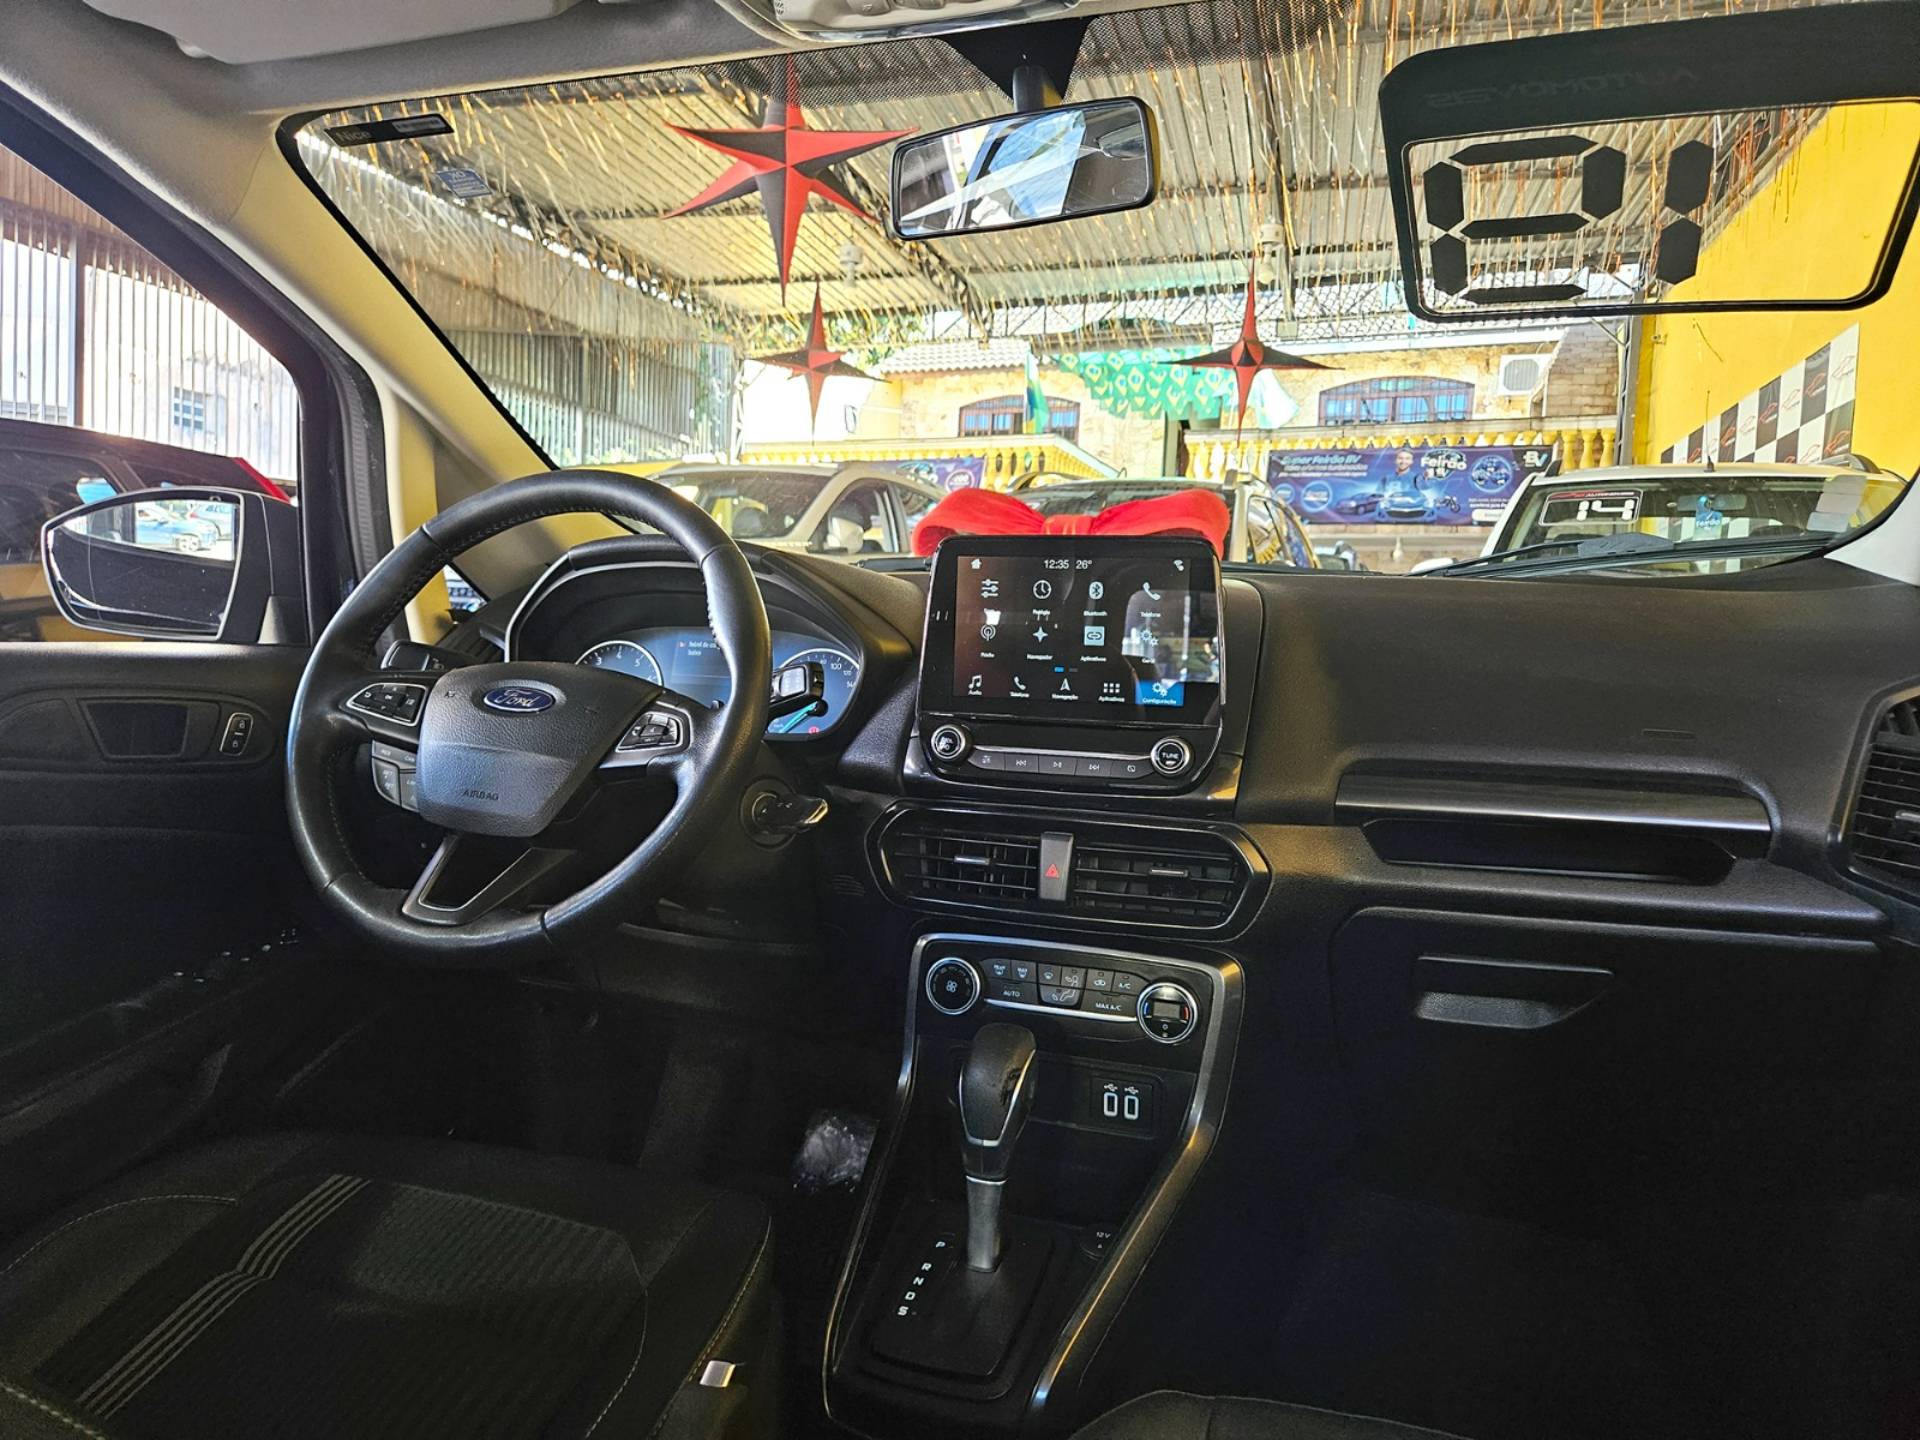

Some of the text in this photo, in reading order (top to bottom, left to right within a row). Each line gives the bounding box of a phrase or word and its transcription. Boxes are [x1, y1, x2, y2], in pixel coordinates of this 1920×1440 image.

[1576, 499, 1635, 522] 14
[1043, 560, 1069, 569] 12:35
[596, 657, 602, 666] 3
[494, 689, 541, 707] Ford
[1161, 752, 1179, 760] TUNE
[461, 790, 499, 801] AIRBAG
[1003, 990, 1021, 998] AUTO
[1096, 1002, 1110, 1011] MAX
[921, 1262, 932, 1272] R
[913, 1276, 924, 1286] N
[905, 1291, 916, 1301] D
[897, 1306, 909, 1316] S
